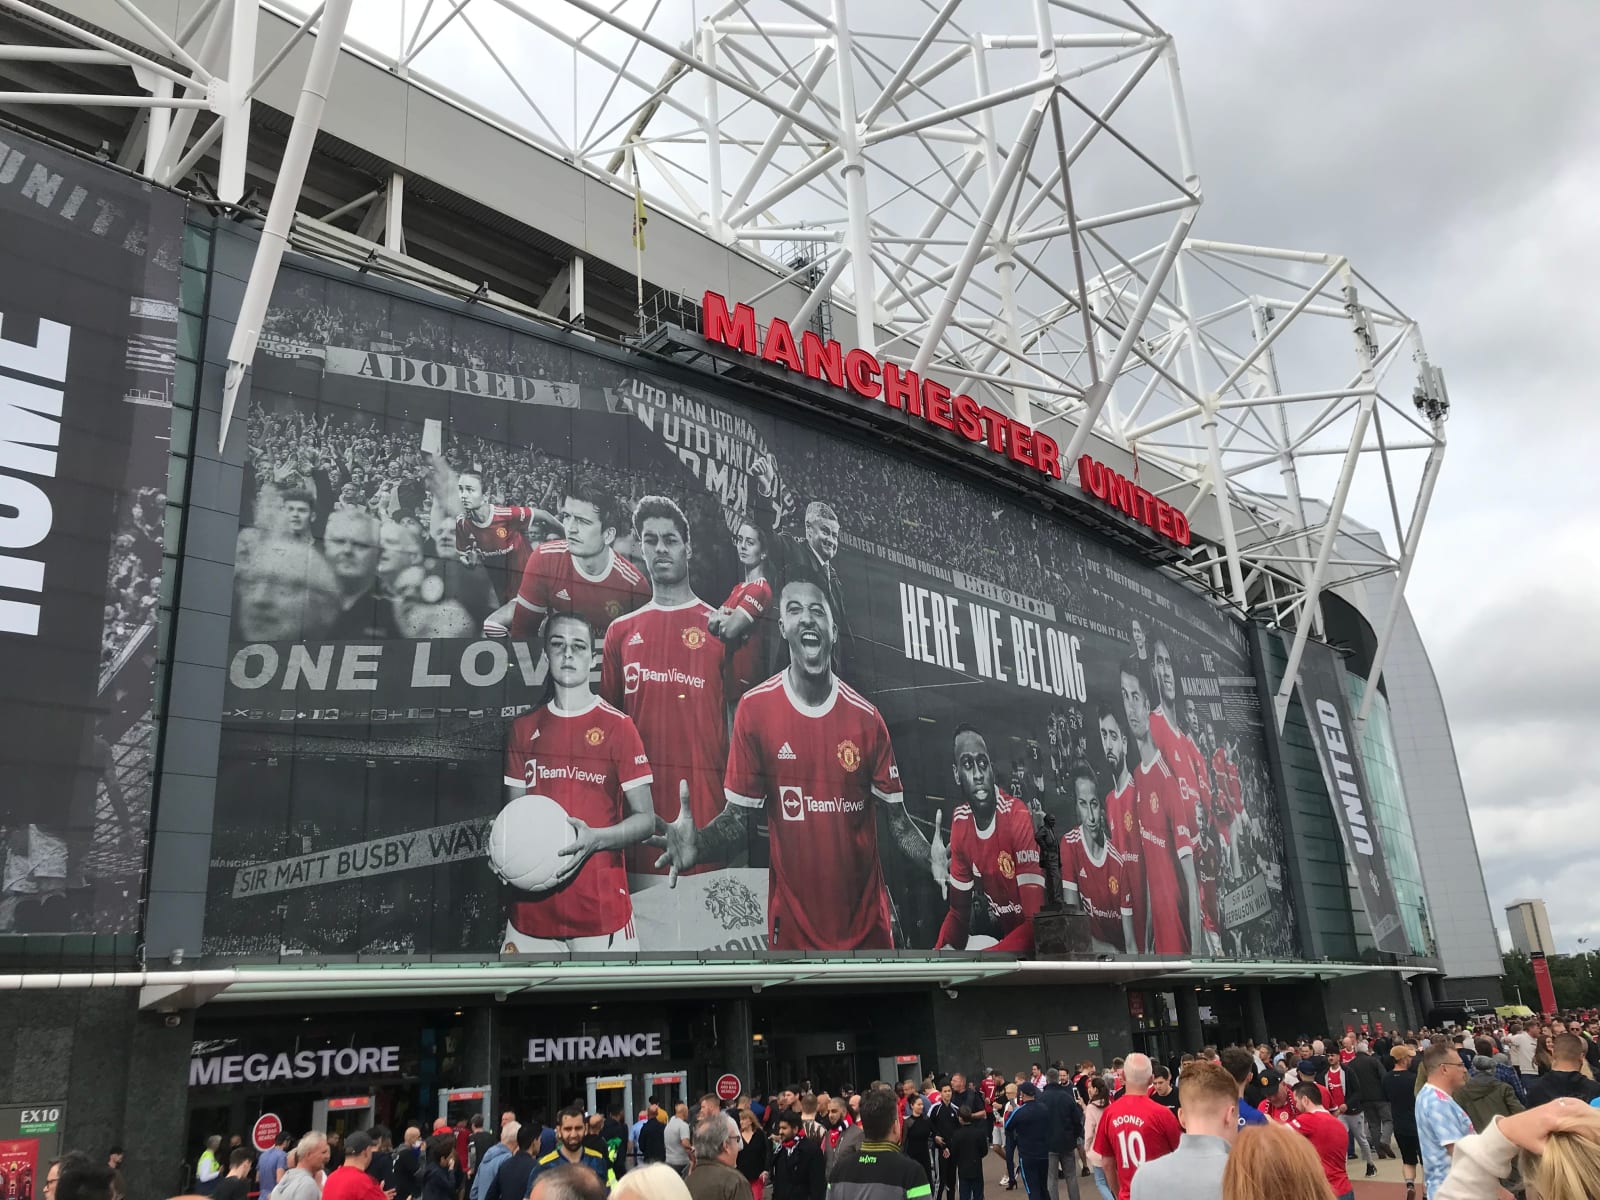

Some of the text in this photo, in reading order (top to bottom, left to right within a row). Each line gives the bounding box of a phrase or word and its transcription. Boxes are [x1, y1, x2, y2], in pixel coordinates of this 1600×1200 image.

[357, 352, 537, 402] ADORED
[632, 379, 667, 410] UTD
[672, 392, 706, 425] MAN
[710, 408, 733, 434] UTD
[702, 290, 1192, 547] MANCHESTER UNITED
[662, 413, 710, 455] UTD
[715, 432, 743, 471] MAN
[705, 457, 748, 516] MAN
[840, 531, 952, 583] GREATEST OF ENGLISH FOOTBALL
[899, 582, 966, 672] HERE
[969, 602, 1008, 682] WE
[1010, 615, 1087, 703] BELONG
[229, 643, 384, 691] ONE
[640, 667, 706, 689] TeamViewer
[536, 764, 608, 786] TeamViewer
[1316, 698, 1374, 857] UNITED
[240, 823, 488, 893] SIR MATT BUSBY WAY
[1226, 891, 1269, 924] FERGUSON WAY
[188, 1045, 400, 1086] MEGASTORE
[528, 1032, 662, 1063] ENTRANCE
[836, 1040, 846, 1052] E3
[1028, 1038, 1040, 1046] EX11
[1087, 1033, 1099, 1041] EX12
[20, 1108, 60, 1123] EX10
[987, 1085, 995, 1099] 7
[1112, 1115, 1145, 1128] ROONEY
[1117, 1130, 1147, 1169] 10
